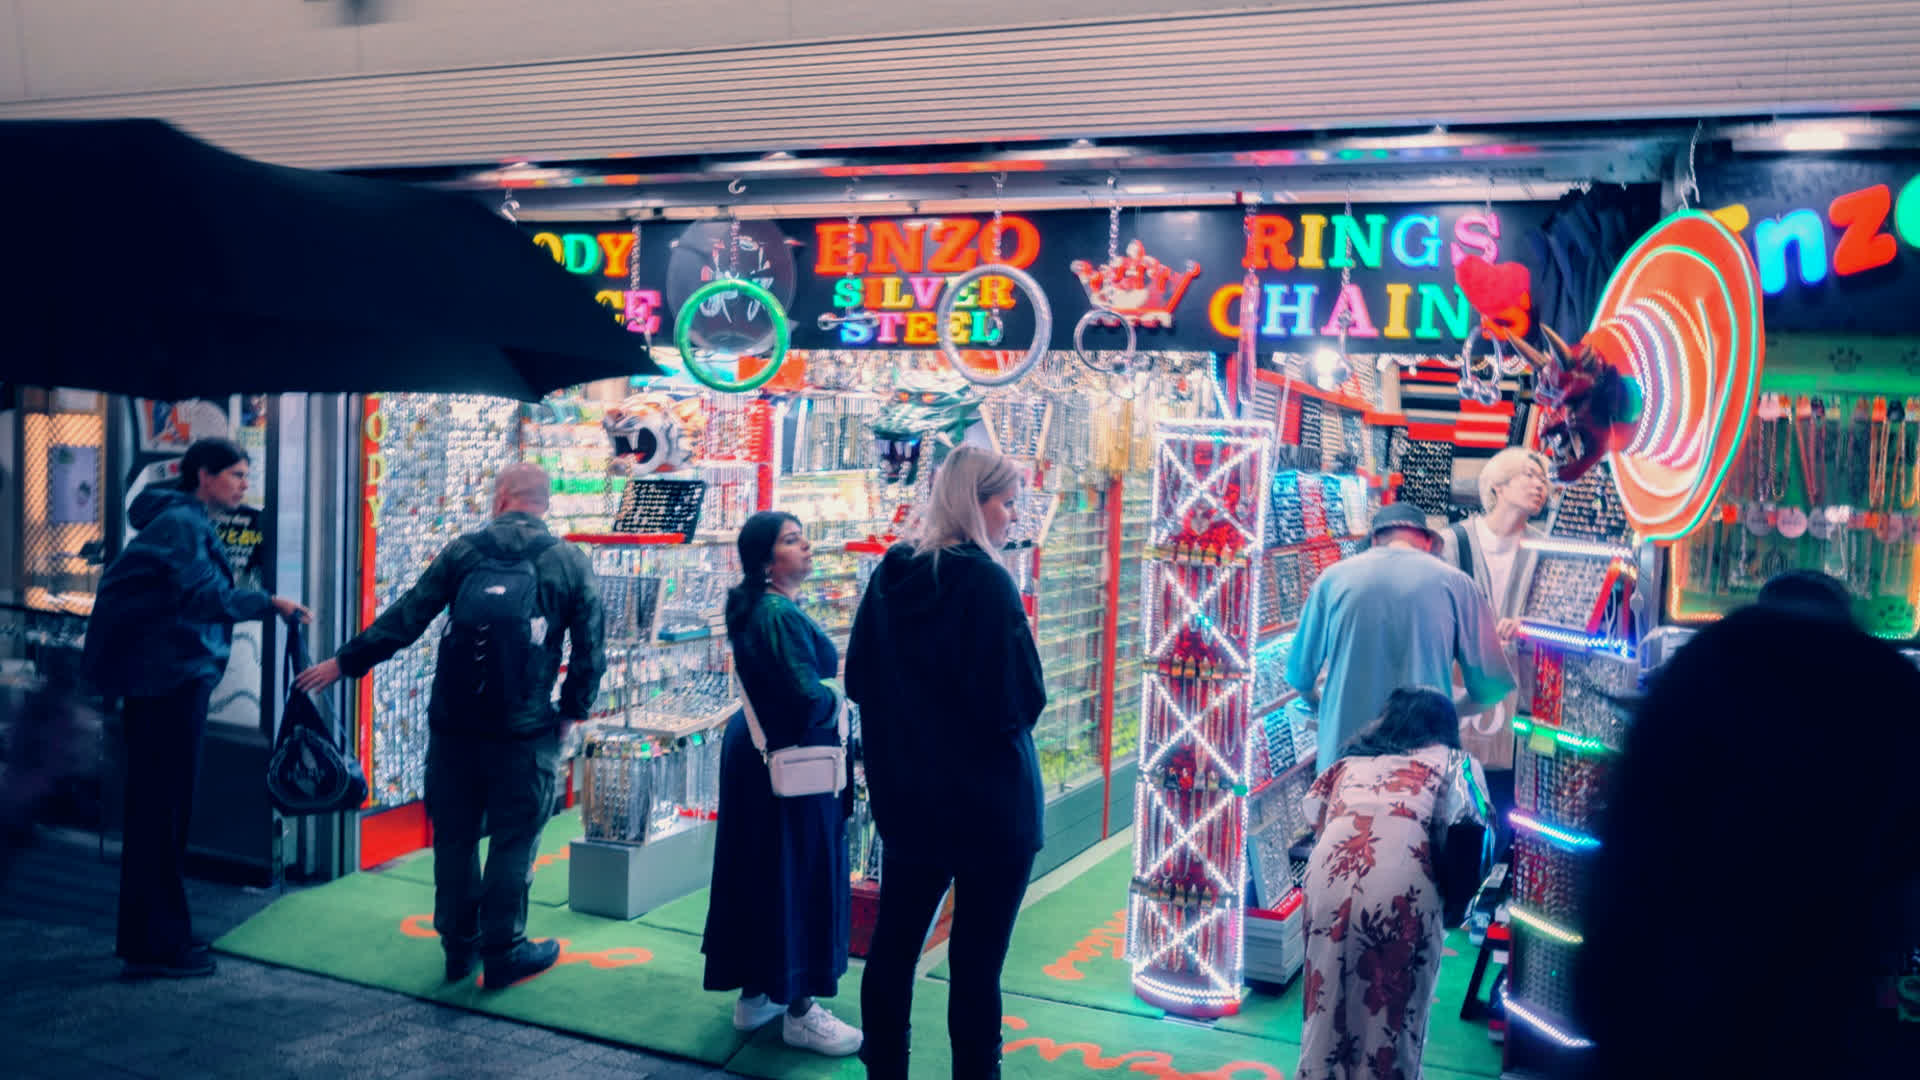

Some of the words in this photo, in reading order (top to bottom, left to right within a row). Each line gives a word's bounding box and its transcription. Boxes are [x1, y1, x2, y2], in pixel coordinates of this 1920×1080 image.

[814, 216, 1041, 274] ENZO
[1242, 213, 1499, 269] RINGS
[833, 274, 1016, 309] SILVER
[840, 311, 1000, 344] STEEL
